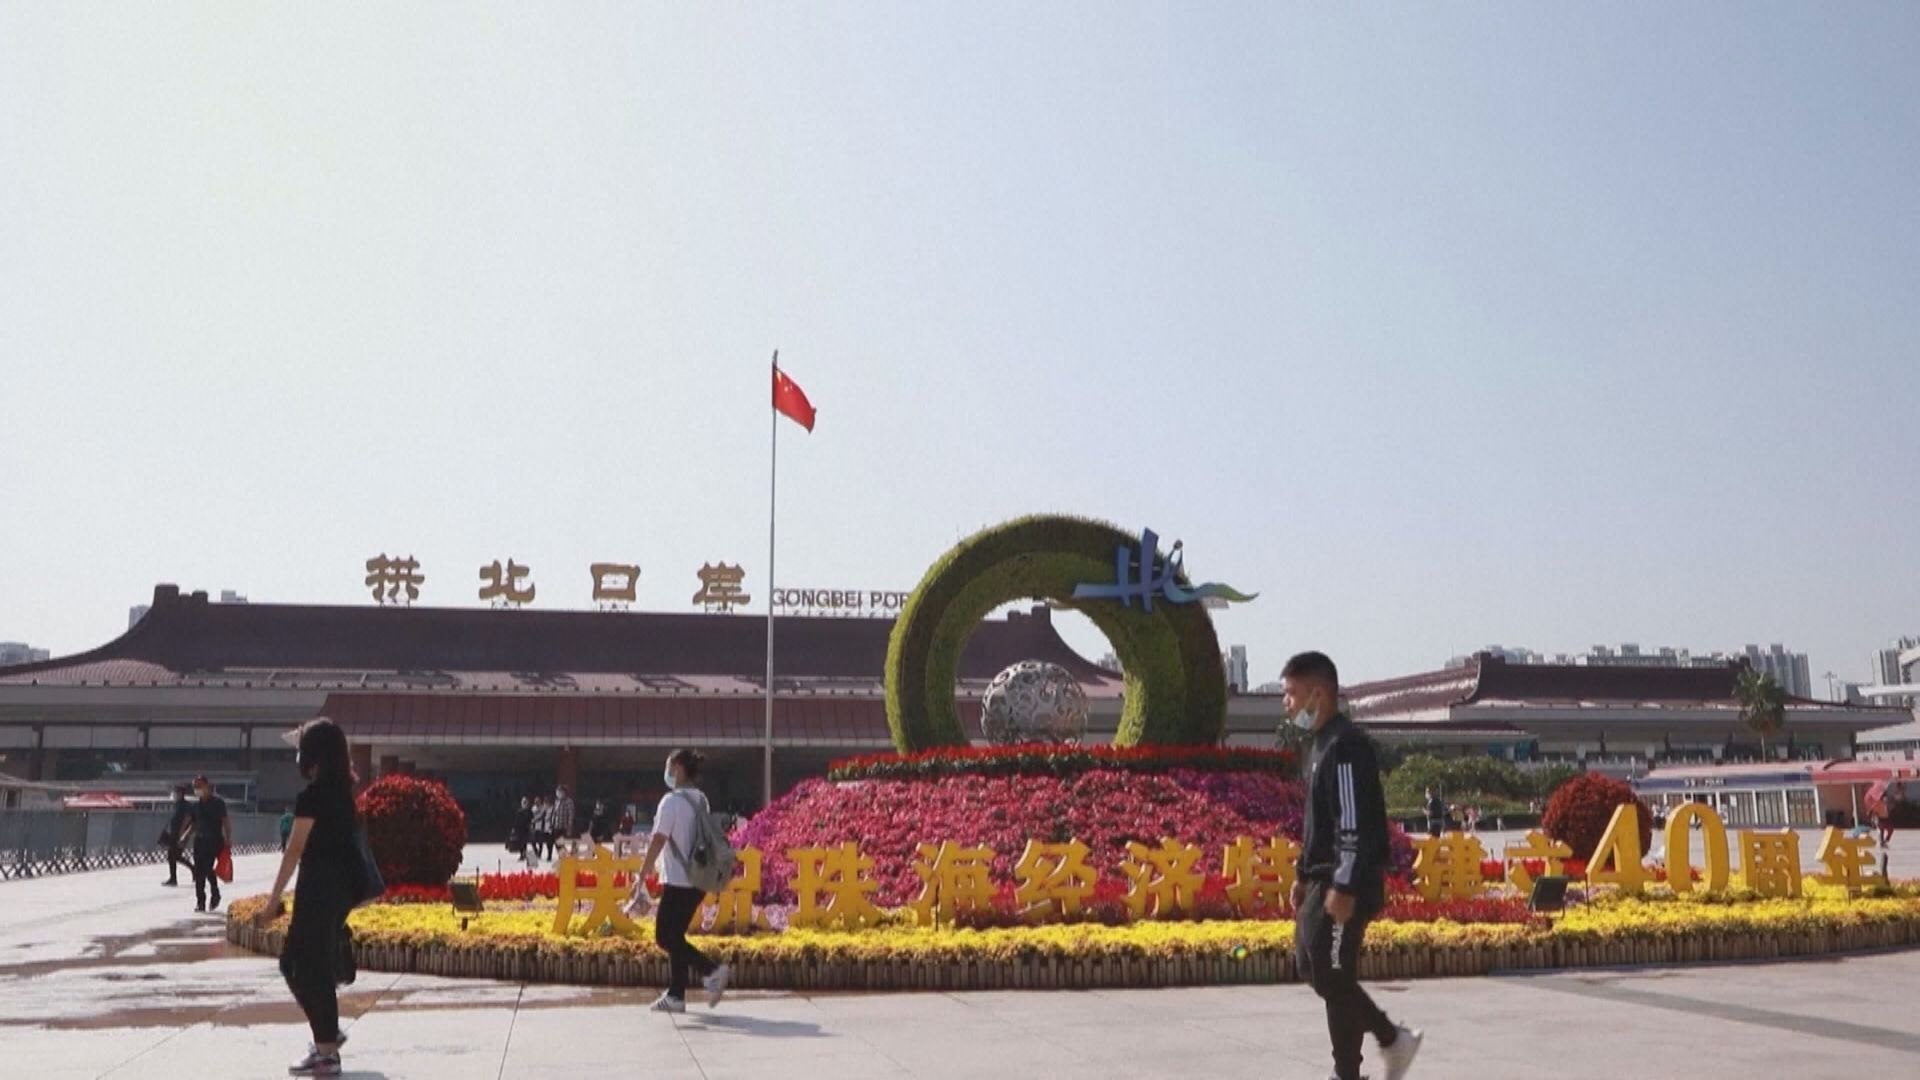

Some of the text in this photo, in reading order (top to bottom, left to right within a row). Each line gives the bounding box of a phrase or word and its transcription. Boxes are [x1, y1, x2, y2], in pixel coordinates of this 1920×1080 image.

[365, 553, 750, 607] 拱北口岸
[772, 588, 912, 609] GONGBEI POR
